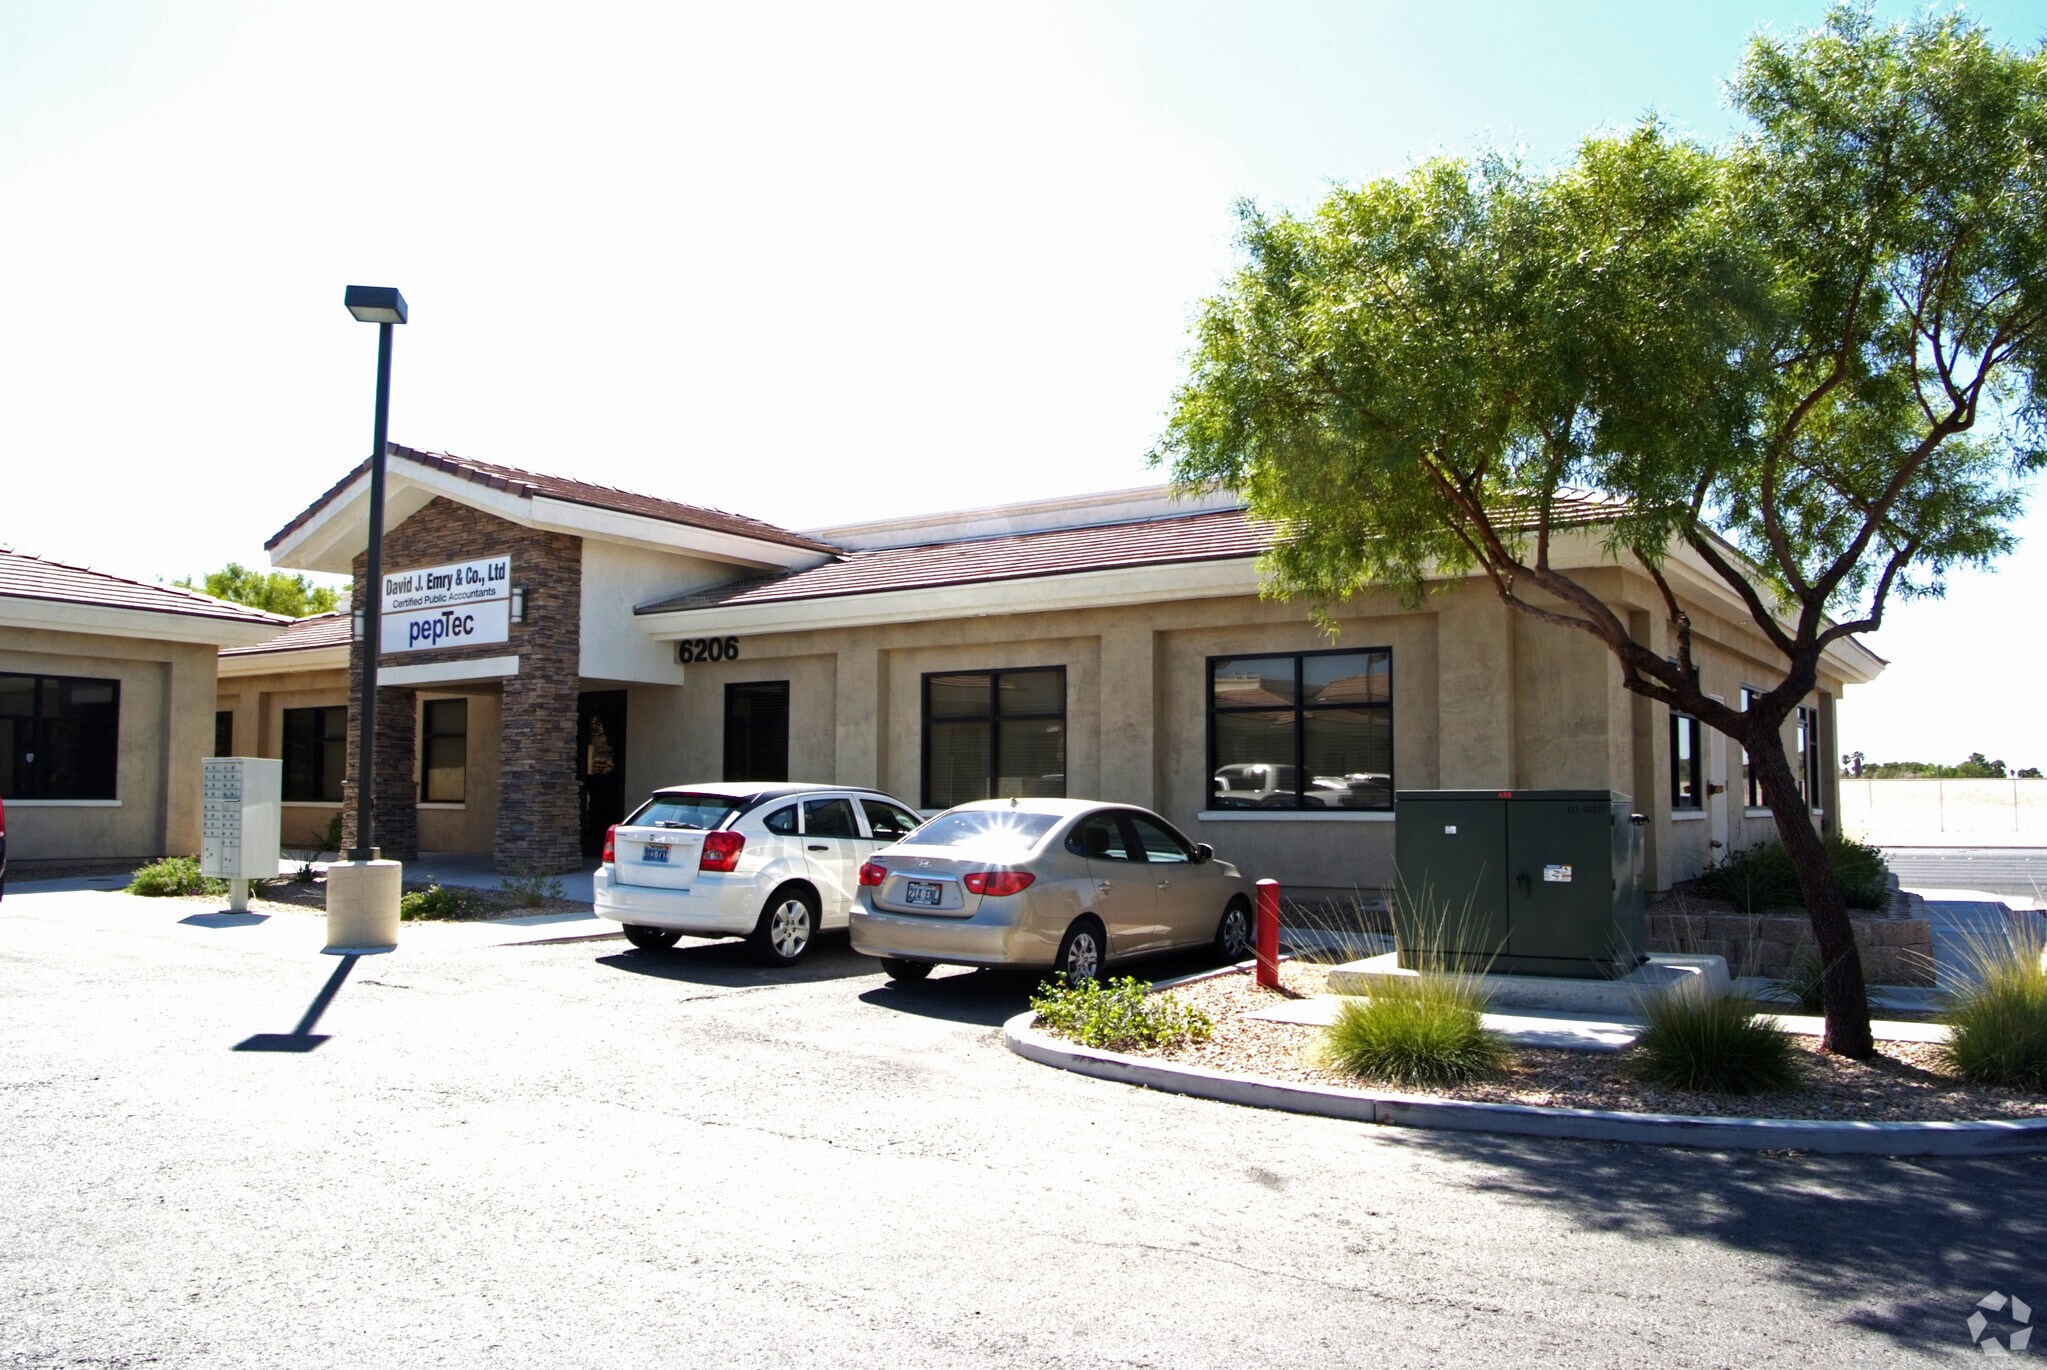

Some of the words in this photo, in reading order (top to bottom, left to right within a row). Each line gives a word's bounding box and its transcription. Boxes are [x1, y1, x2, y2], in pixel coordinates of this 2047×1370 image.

[386, 576, 412, 596] David
[415, 574, 423, 592] J.
[426, 572, 453, 591] Emry
[455, 568, 463, 586] &
[465, 566, 485, 586] Co.,
[488, 562, 506, 582] Ltd
[392, 596, 423, 609] Certified
[424, 593, 447, 605] Public
[448, 587, 496, 601] Accountants
[409, 610, 474, 648] pepTec
[679, 635, 739, 664] 6206
